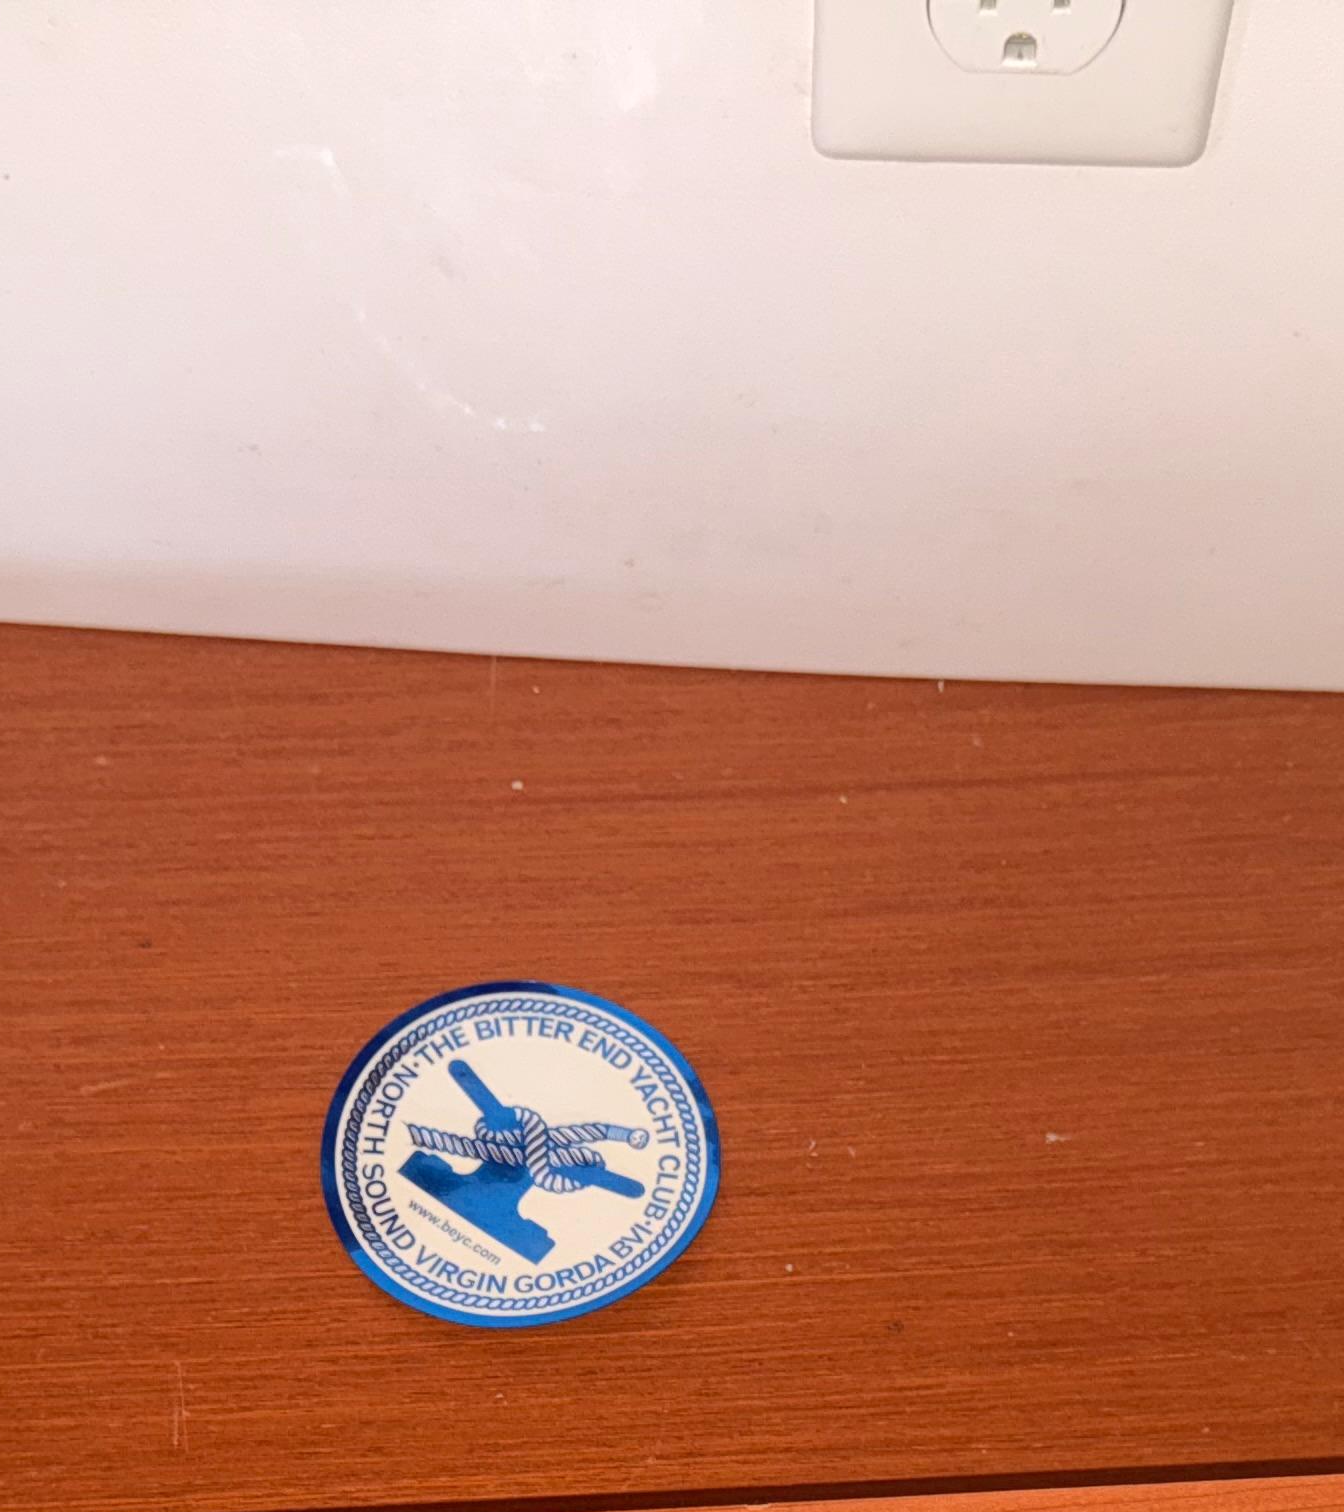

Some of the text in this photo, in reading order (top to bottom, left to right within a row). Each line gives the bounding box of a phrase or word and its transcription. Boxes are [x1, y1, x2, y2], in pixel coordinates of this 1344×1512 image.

[361, 1062, 648, 1295] NORTH SOUND VIRGIN GORDA BVI
[415, 1014, 681, 1220] THE BITTER END YACHT CLUB
[407, 1199, 502, 1267] www.beyc.com
